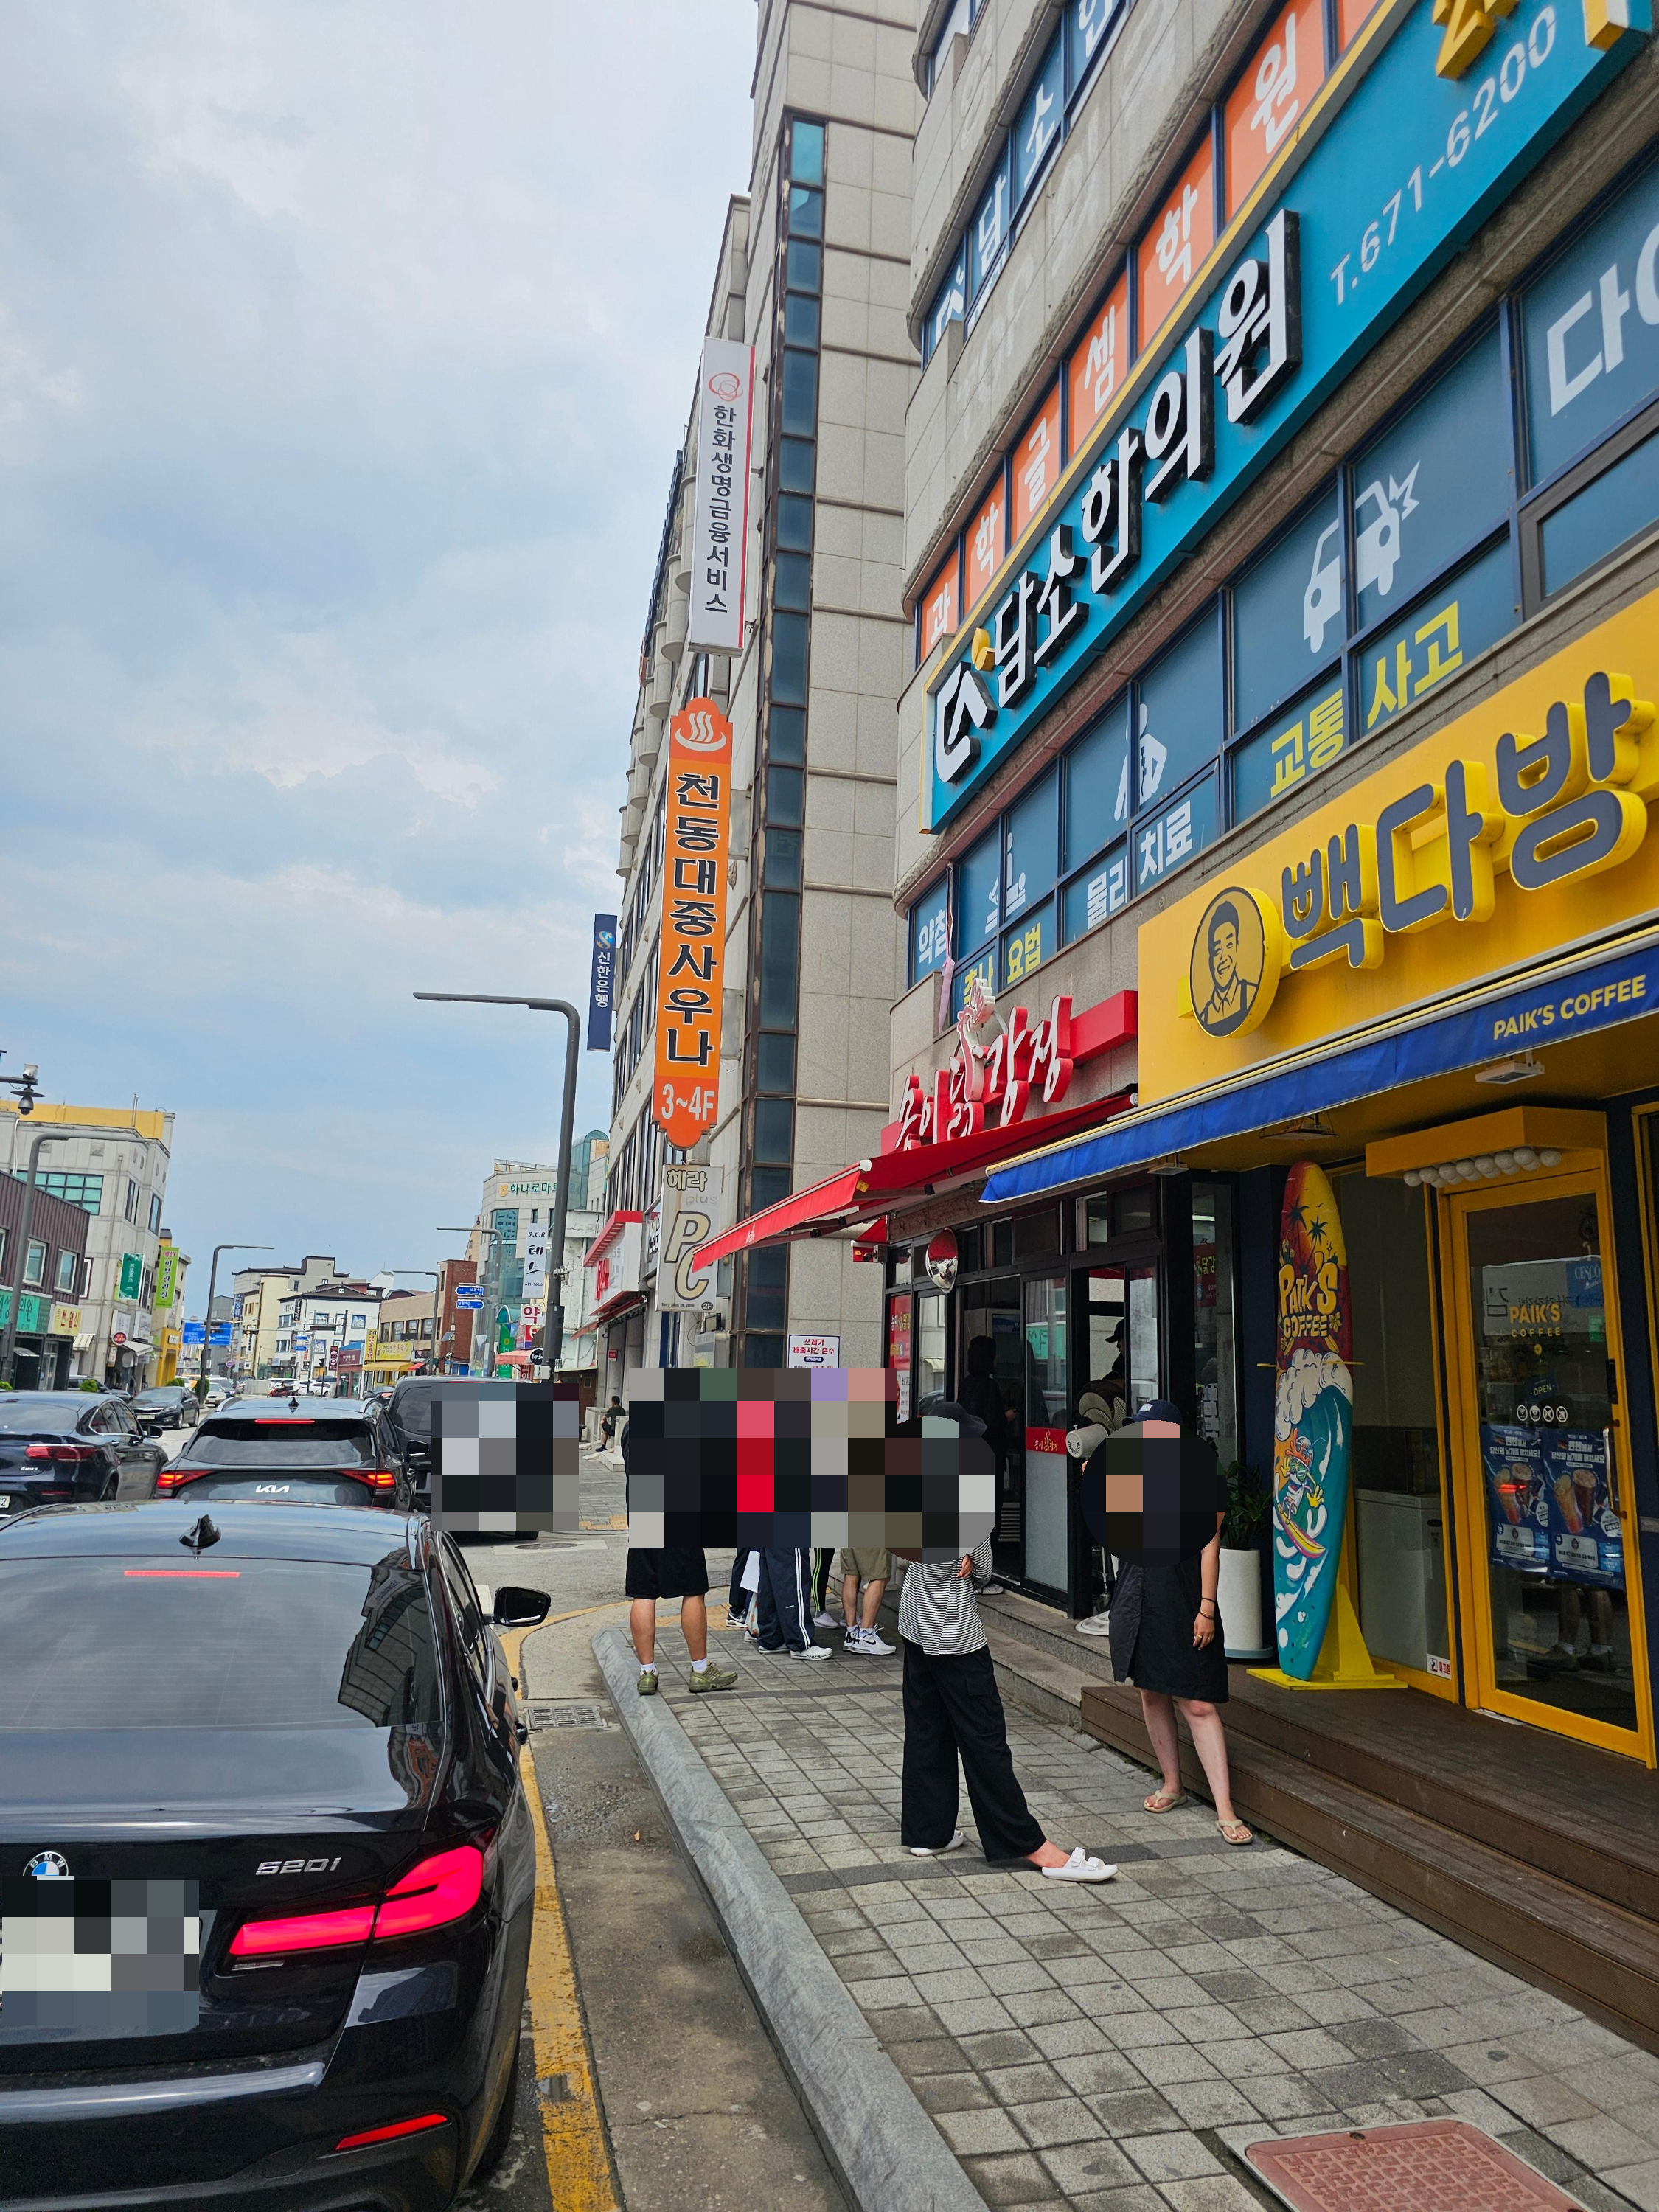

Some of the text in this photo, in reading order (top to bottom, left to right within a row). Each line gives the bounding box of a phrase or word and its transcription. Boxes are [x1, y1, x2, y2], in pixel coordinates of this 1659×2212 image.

[1330, 6, 1556, 305] T.671-6200
[995, 209, 1301, 709] 담소한의원
[705, 405, 737, 614] 한화생명금융서비스
[1366, 600, 1464, 728] 사고
[1270, 688, 1345, 798] 교통
[1281, 672, 1656, 970] 빽다방
[1087, 801, 1194, 930] 물리 치료
[664, 772, 721, 1068] 천동대중사우나
[594, 951, 611, 1009] 신한은행
[1007, 922, 1041, 984] 요법
[1495, 974, 1646, 1042] PAIK'S COFFEE
[661, 1084, 717, 1123] 3~4F
[667, 1169, 708, 1192] 헤라
[685, 1194, 717, 1206] plus
[664, 1211, 713, 1301] PC
[1278, 1251, 1338, 1318] PAIK'S
[523, 1306, 540, 1324] 약
[1283, 1314, 1329, 1339] COFFEE
[1509, 1302, 1562, 1324] PAIK'S
[1511, 1326, 1562, 1338] COFFEE
[793, 1346, 819, 1354] 배출시간
[1533, 1382, 1552, 1396] OPEN
